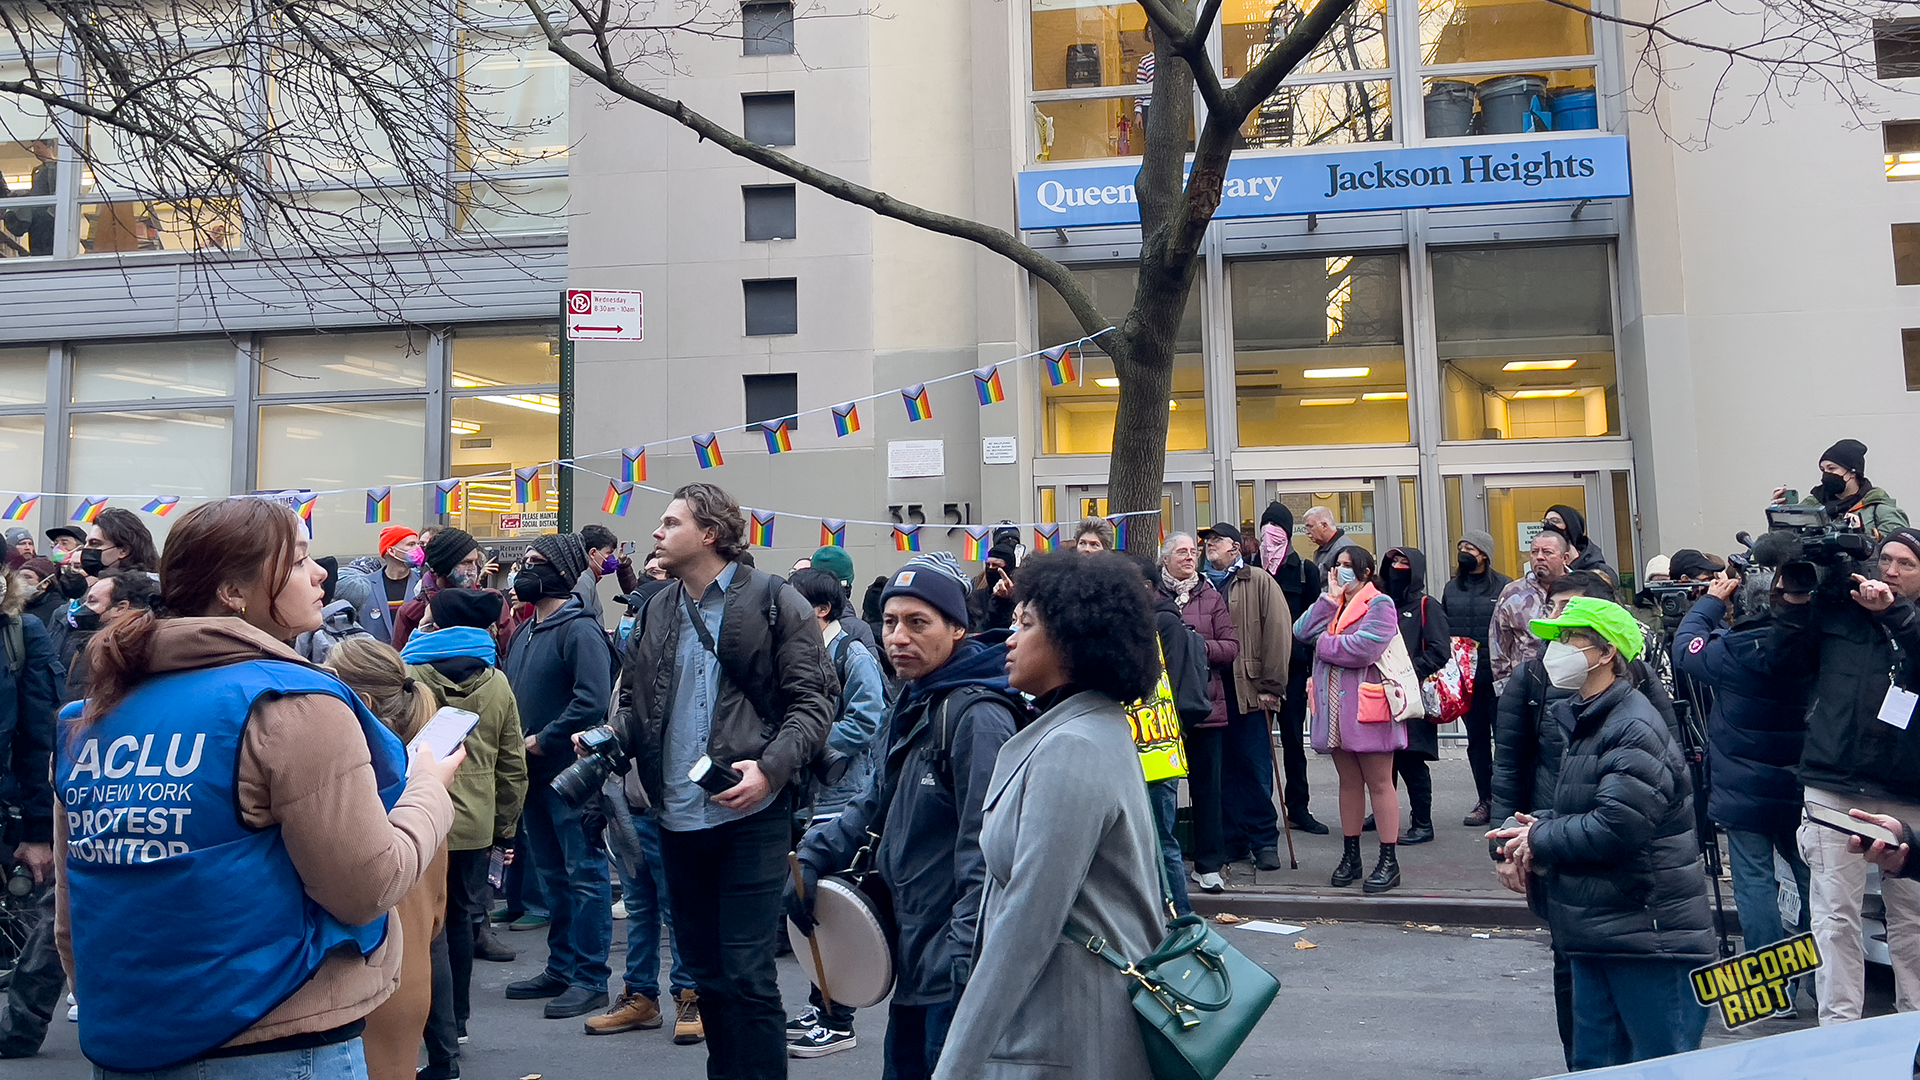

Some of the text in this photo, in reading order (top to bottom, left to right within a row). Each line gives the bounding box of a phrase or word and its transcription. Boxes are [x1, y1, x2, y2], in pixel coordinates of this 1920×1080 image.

[1036, 180, 1138, 213] Queen
[1324, 161, 1452, 199] Jackson
[1459, 151, 1595, 186] Heights
[594, 296, 626, 304] Wednesday
[68, 733, 206, 781] ACLU
[66, 782, 194, 805] OF NEW YORK
[67, 807, 192, 836] PROTEST
